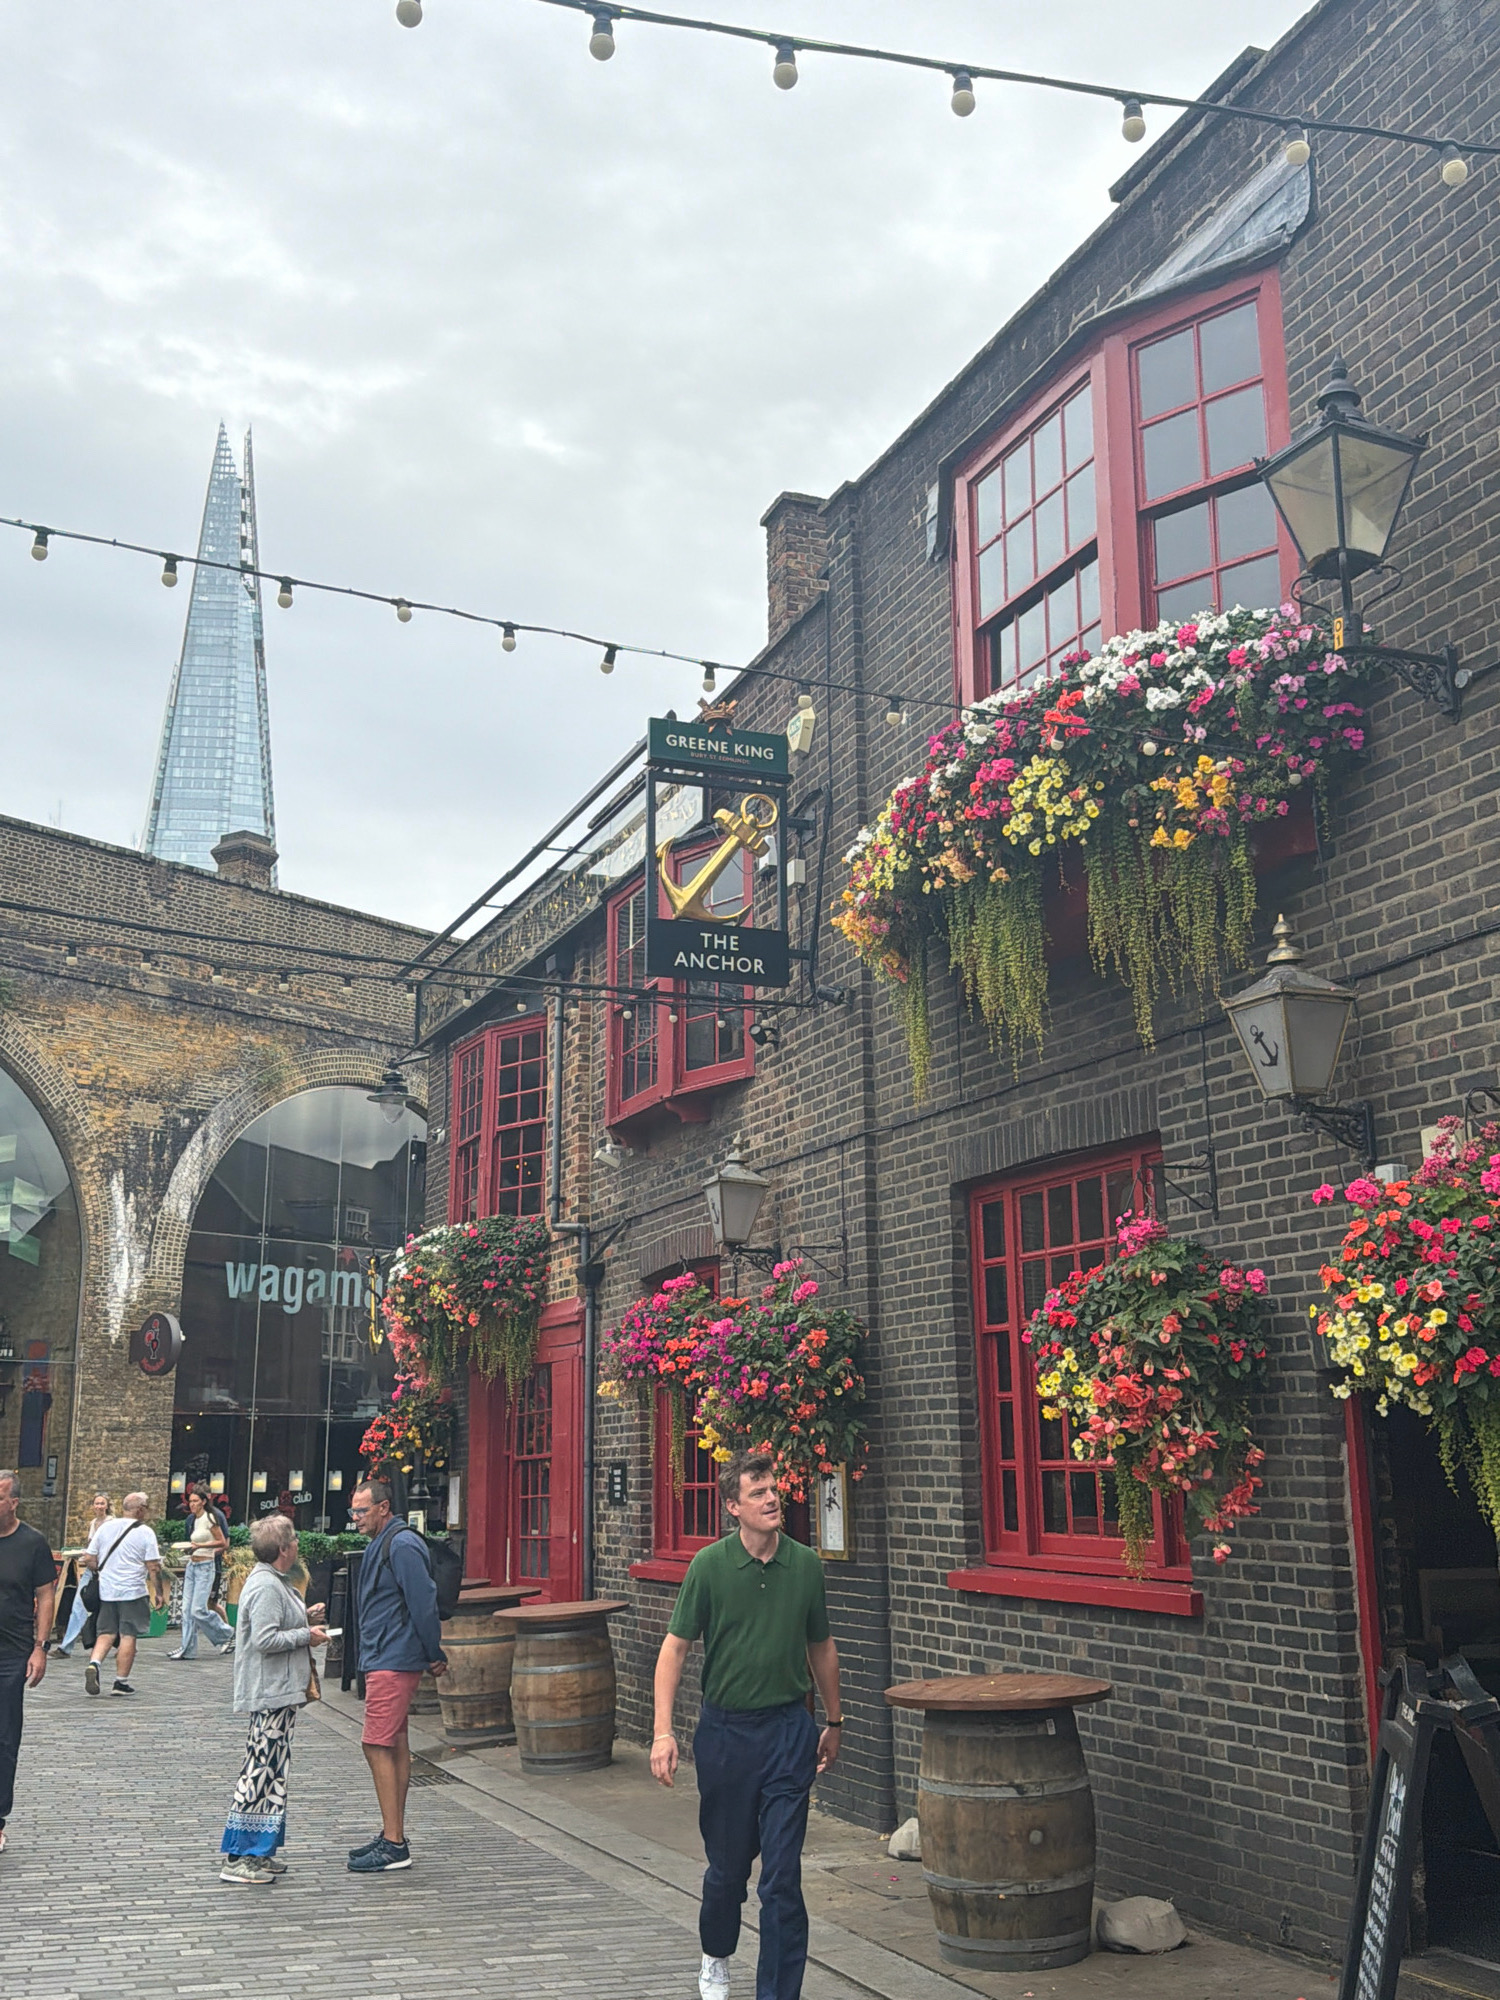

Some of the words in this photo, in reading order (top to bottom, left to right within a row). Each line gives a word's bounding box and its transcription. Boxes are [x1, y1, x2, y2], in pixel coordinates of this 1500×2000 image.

[666, 734, 728, 754] GREENE
[734, 743, 774, 760] KING
[700, 932, 739, 951] THE
[674, 951, 765, 974] ANCHOR
[260, 1496, 279, 1510] soul
[293, 1491, 312, 1504] club
